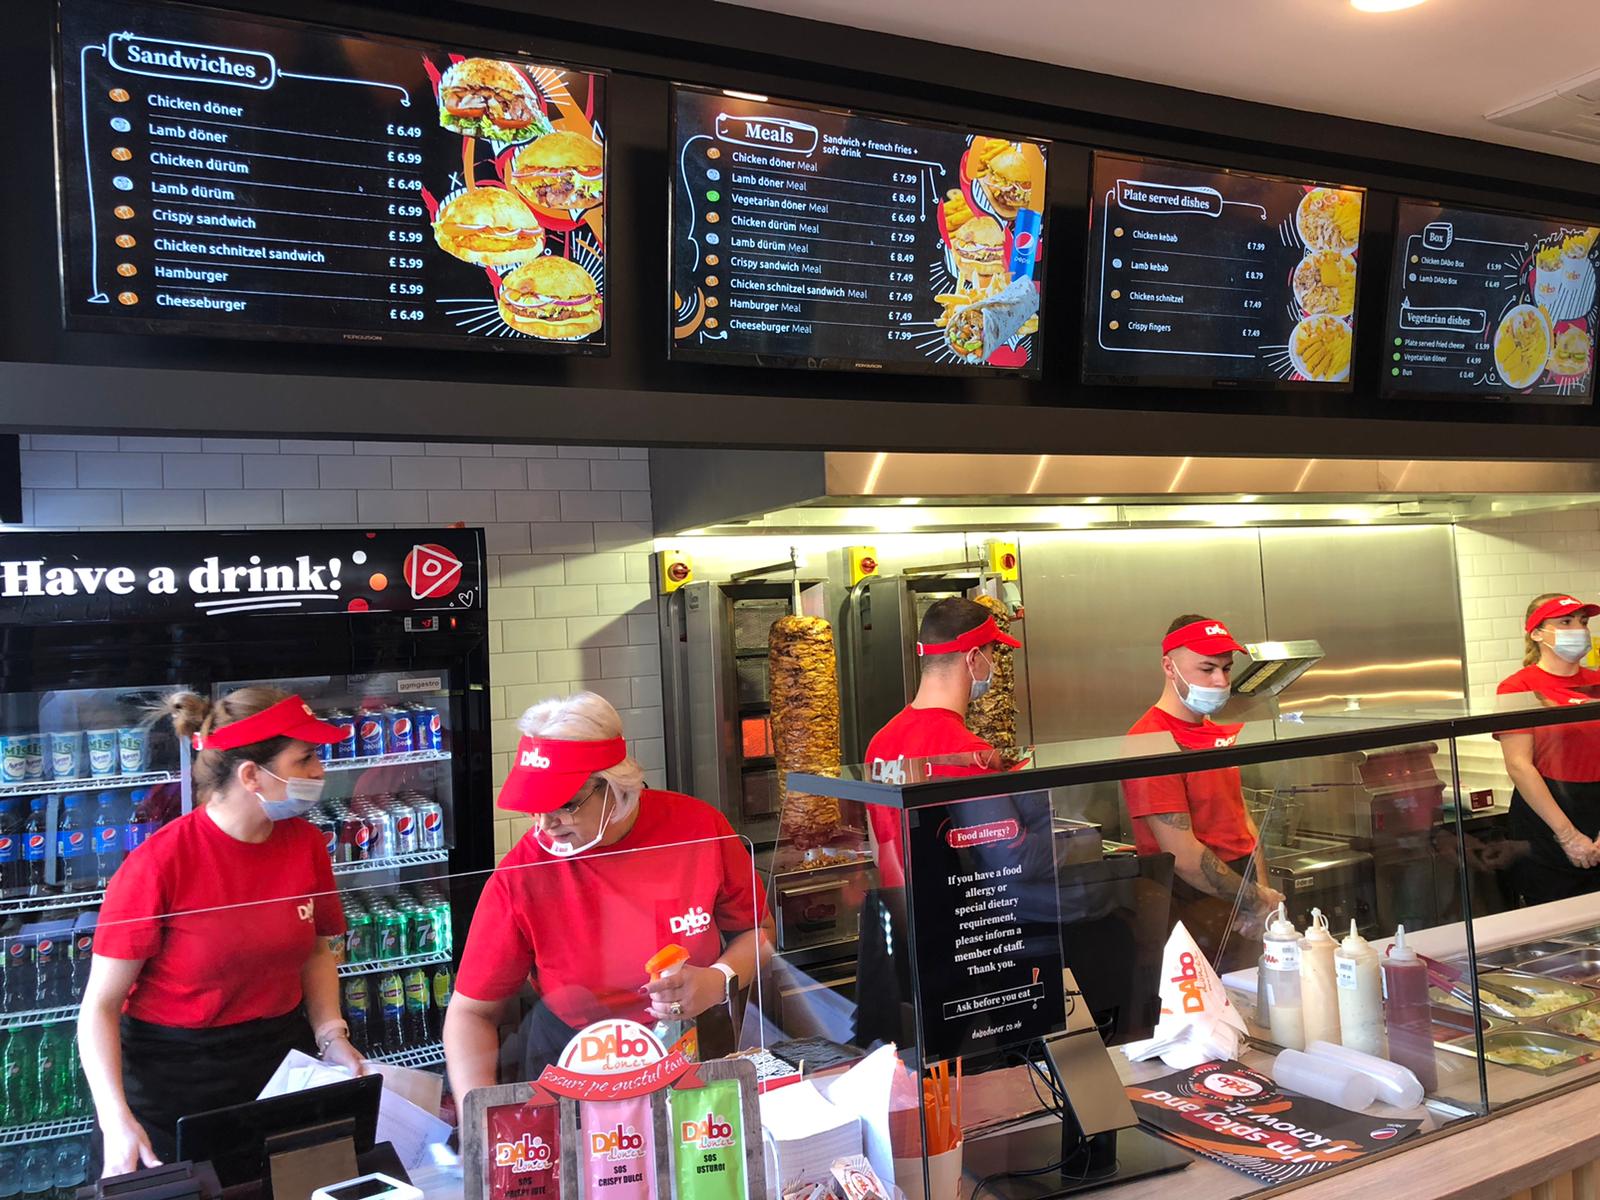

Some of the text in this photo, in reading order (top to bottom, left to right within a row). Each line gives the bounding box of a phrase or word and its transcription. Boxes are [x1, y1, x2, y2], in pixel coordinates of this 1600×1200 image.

[127, 45, 256, 79] Sandwiches
[148, 94, 243, 117] Chicken döner
[149, 123, 228, 143] Lamb döner
[745, 122, 793, 144] Meals
[823, 134, 912, 154] Sandwich french fries
[823, 146, 861, 158] soft drink
[150, 152, 249, 174] Chicken dürüm
[732, 152, 817, 172] Chicken döner Meal
[152, 181, 234, 200] Lamb dürüm
[732, 173, 806, 191] Lamb döner Meal
[732, 194, 828, 213] Vegetarian döner Meal
[1124, 189, 1210, 209] Plate served dishes
[153, 209, 256, 229] Crispy sandwich
[732, 216, 819, 234] Chicken dürüm Meal
[731, 237, 808, 253] Lamb dürüm Meal
[1133, 230, 1178, 242] Chicken kebab
[1430, 232, 1443, 242] Box
[154, 238, 325, 263] Chicken schnitzel sandwich
[155, 266, 229, 283] Hamburger
[731, 257, 821, 273] Crispy sandwich Meal
[1131, 261, 1169, 272] Lamb kebab
[731, 279, 867, 299] Chicken schnitzel sandwich Meal
[1130, 292, 1183, 303] Chicken schnitzel
[156, 294, 247, 311] Cheeseburger
[730, 299, 801, 313] Hamburger Meal
[730, 320, 811, 334] Cheeseburger Meal
[1128, 322, 1171, 333] Crispy fingers
[1407, 313, 1470, 326] Vegetarian dishes
[0, 555, 342, 597] Have a drink!
[957, 826, 1010, 841] Food allergy?
[948, 875, 956, 885] If
[957, 874, 973, 886] you
[975, 870, 994, 880] have
[1003, 864, 1022, 875] food
[965, 884, 1007, 898] allergy or
[955, 897, 1019, 917] special dietary
[960, 913, 1016, 930] requirement,
[955, 935, 984, 948] please
[985, 928, 1015, 940] inform
[954, 940, 1025, 962] member of staff.
[967, 959, 1016, 976] Thank you.
[956, 989, 1031, 1013] Ask before you eat
[543, 1071, 586, 1091] sosuri
[585, 1081, 607, 1097] pe
[612, 1064, 662, 1097] gustul
[1142, 1090, 1200, 1112] and
[1194, 1112, 1270, 1141] spicy
[1224, 1103, 1348, 1154] I know it
[703, 1154, 717, 1163] SOS
[1266, 1140, 1316, 1163] I'm
[614, 1165, 627, 1174] SOS
[696, 1163, 726, 1174] USTUROI
[598, 1172, 643, 1187] CRISPY DULCE
